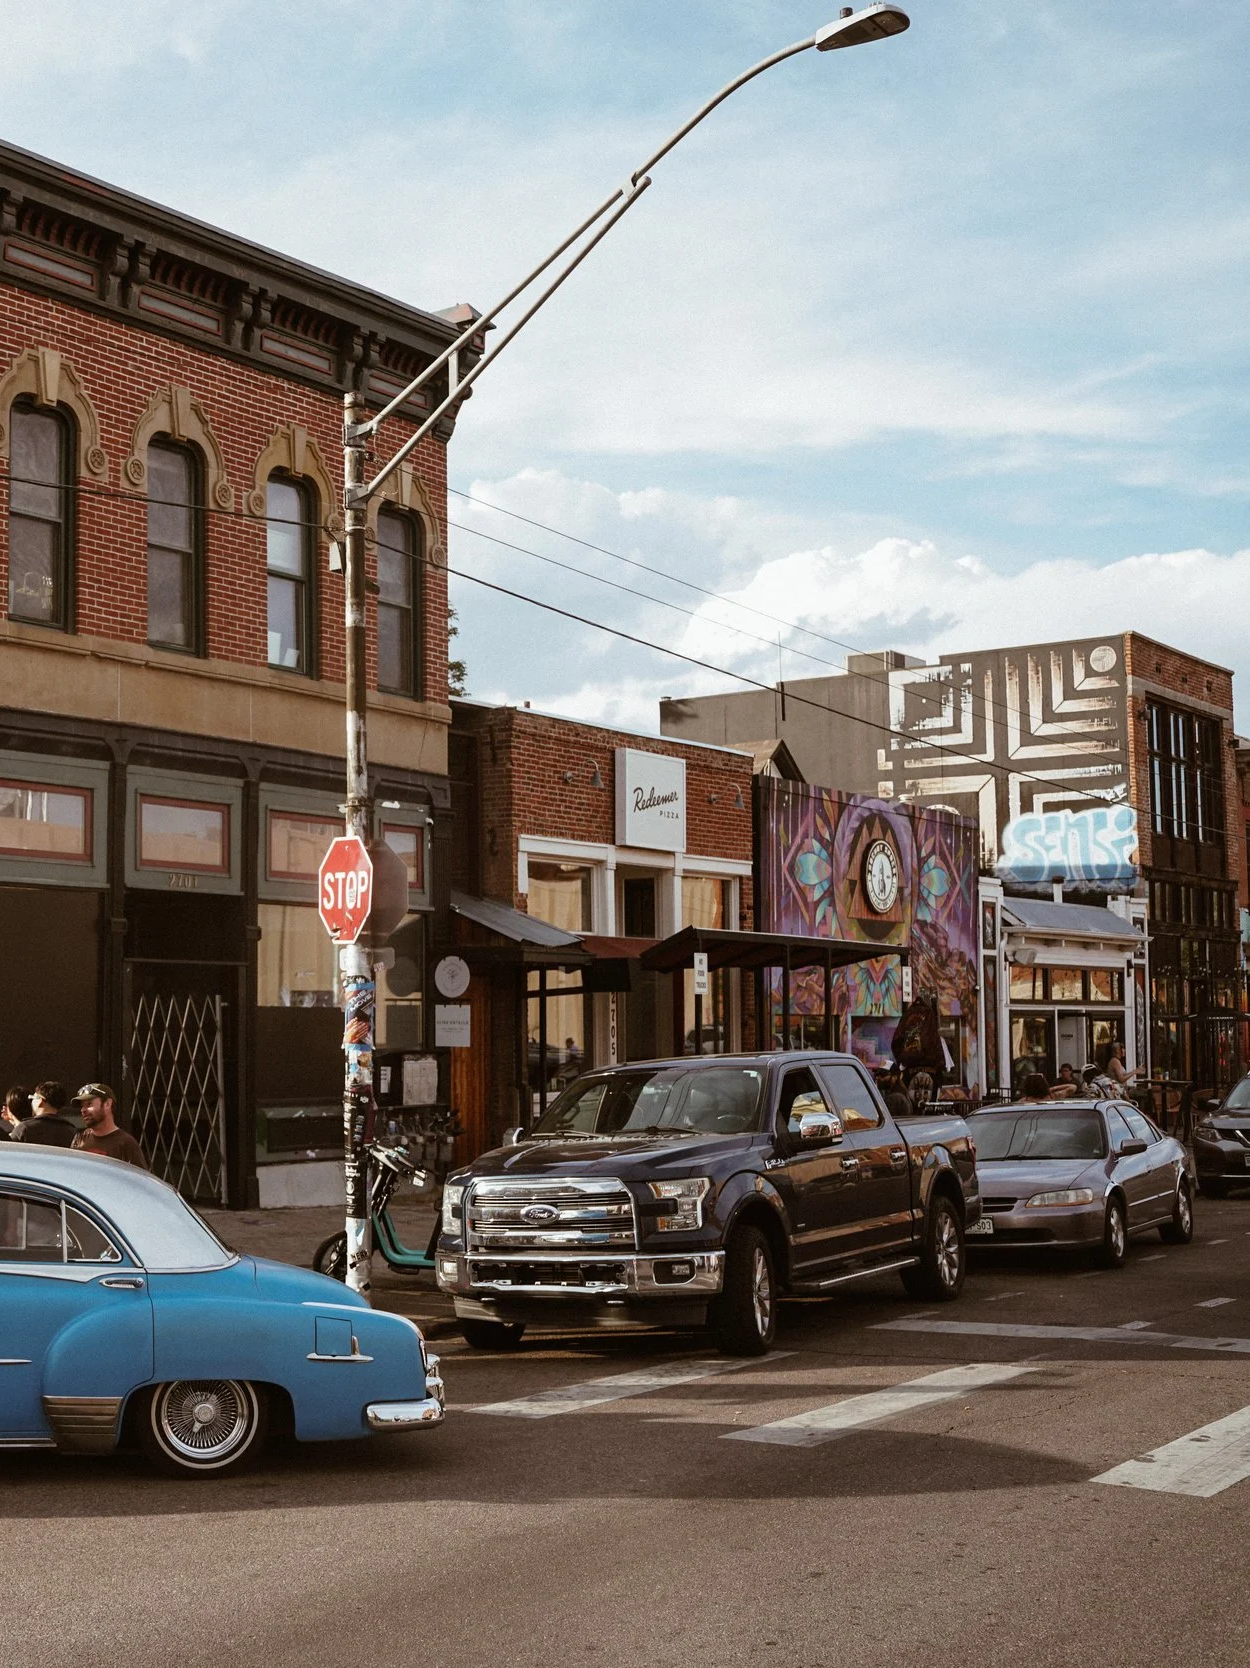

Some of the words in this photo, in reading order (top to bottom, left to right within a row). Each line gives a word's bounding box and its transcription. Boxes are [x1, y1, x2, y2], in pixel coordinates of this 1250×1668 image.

[633, 786, 679, 813] Redeemer
[659, 810, 679, 819] PIZZA
[168, 873, 198, 888] 2701
[323, 870, 368, 910] STOP
[349, 990, 367, 1005] THE
[350, 993, 373, 1012] MOVE
